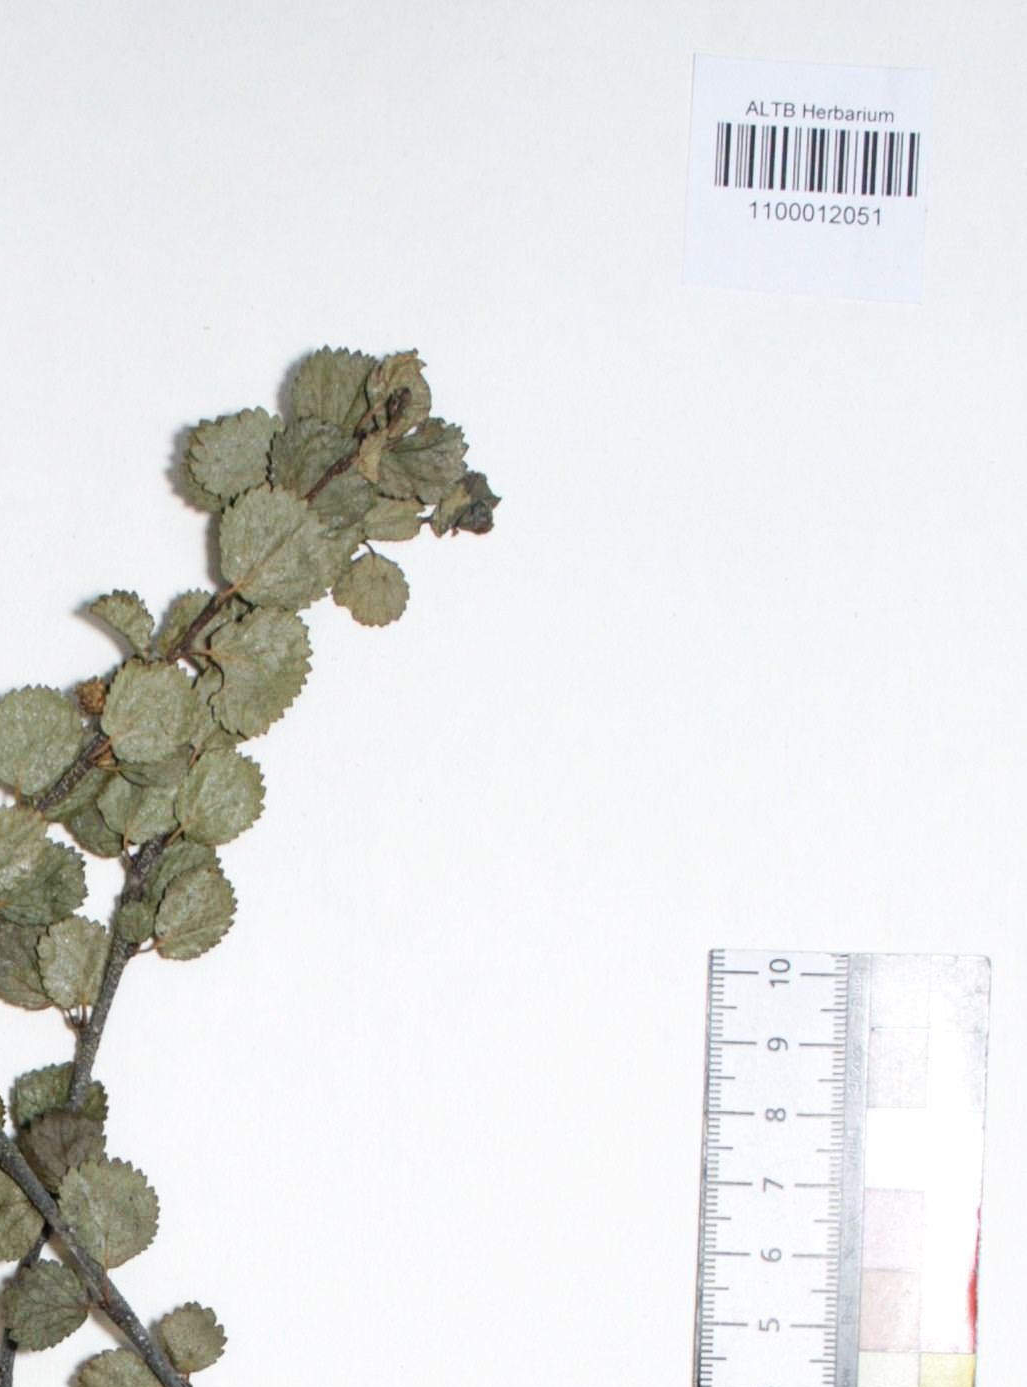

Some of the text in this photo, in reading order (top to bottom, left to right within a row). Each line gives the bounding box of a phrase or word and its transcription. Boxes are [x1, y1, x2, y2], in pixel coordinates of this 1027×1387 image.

[745, 100, 896, 124] ALTB Herbarium
[748, 200, 882, 227] 1100012051
[769, 958, 791, 988] 10
[767, 1036, 789, 1052] 9
[765, 1107, 787, 1123] 8
[762, 1177, 784, 1193] 7
[760, 1247, 783, 1264] 6
[758, 1317, 780, 1333] 5
